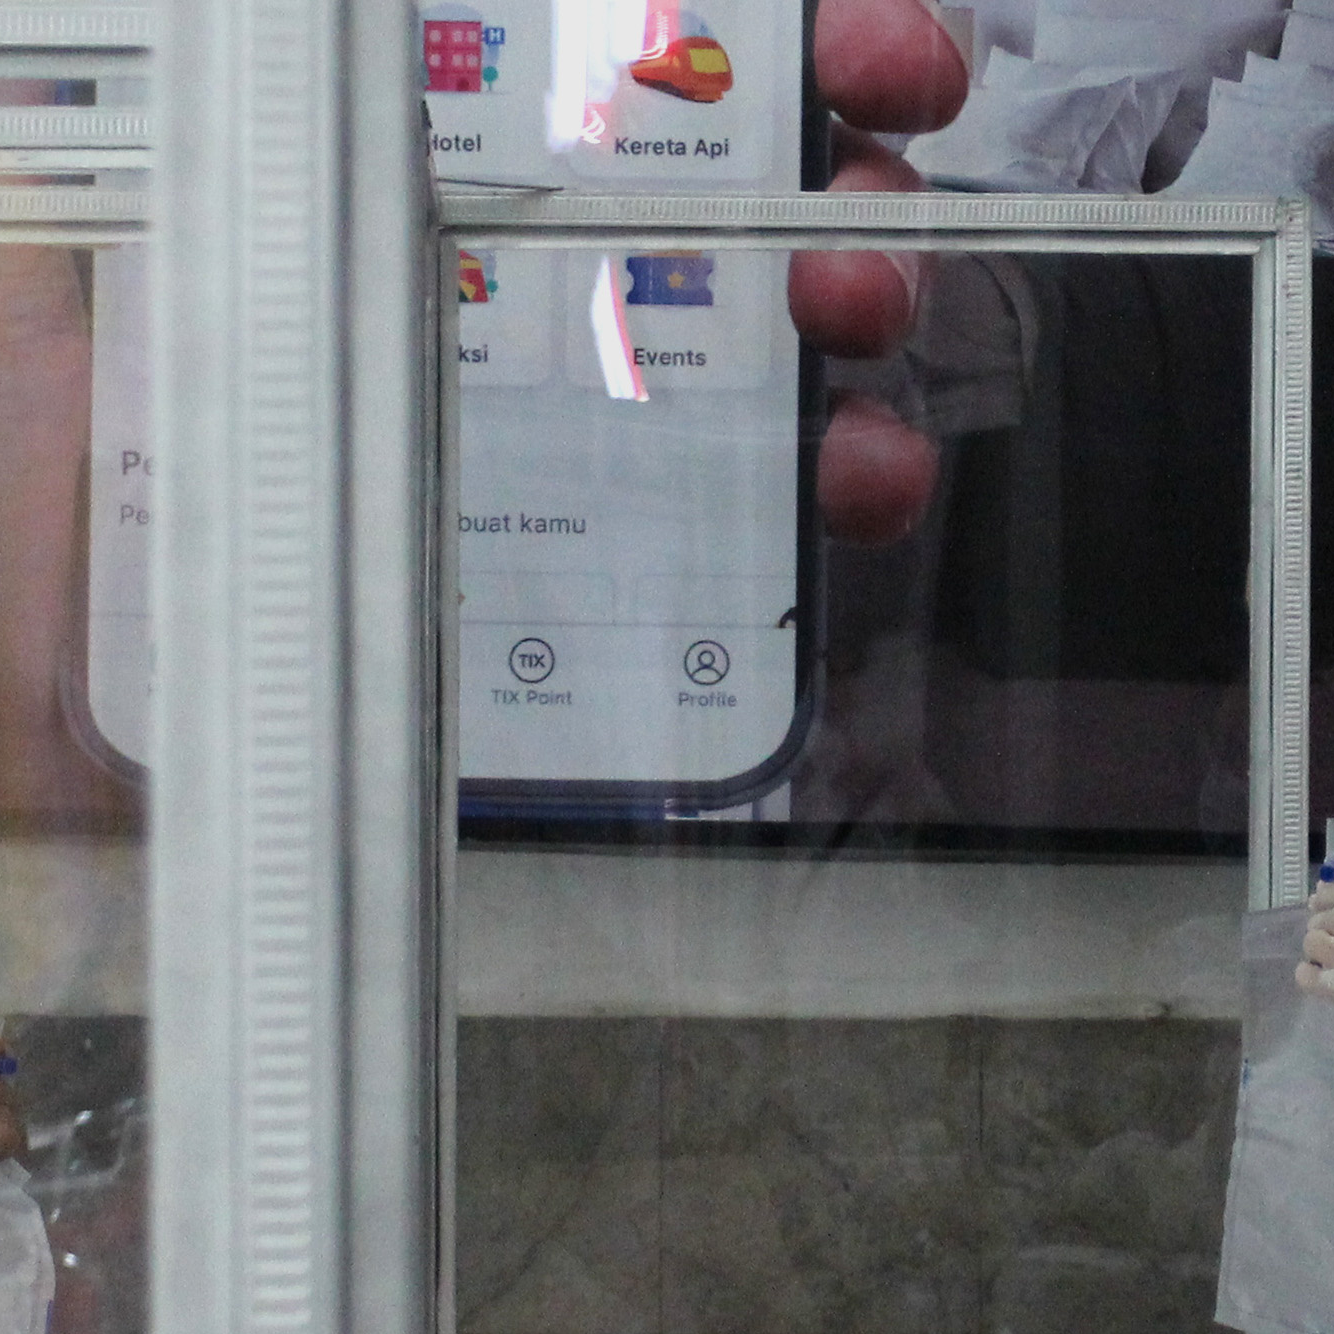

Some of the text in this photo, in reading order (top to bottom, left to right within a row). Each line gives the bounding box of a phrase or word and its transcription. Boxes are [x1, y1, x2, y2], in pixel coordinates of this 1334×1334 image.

[614, 137, 729, 160] Kereta Api
[633, 348, 707, 366] Events
[458, 511, 586, 534] buat kamu
[518, 653, 546, 668] TIX
[491, 689, 572, 705] TIX Point
[678, 691, 738, 707] Profile
